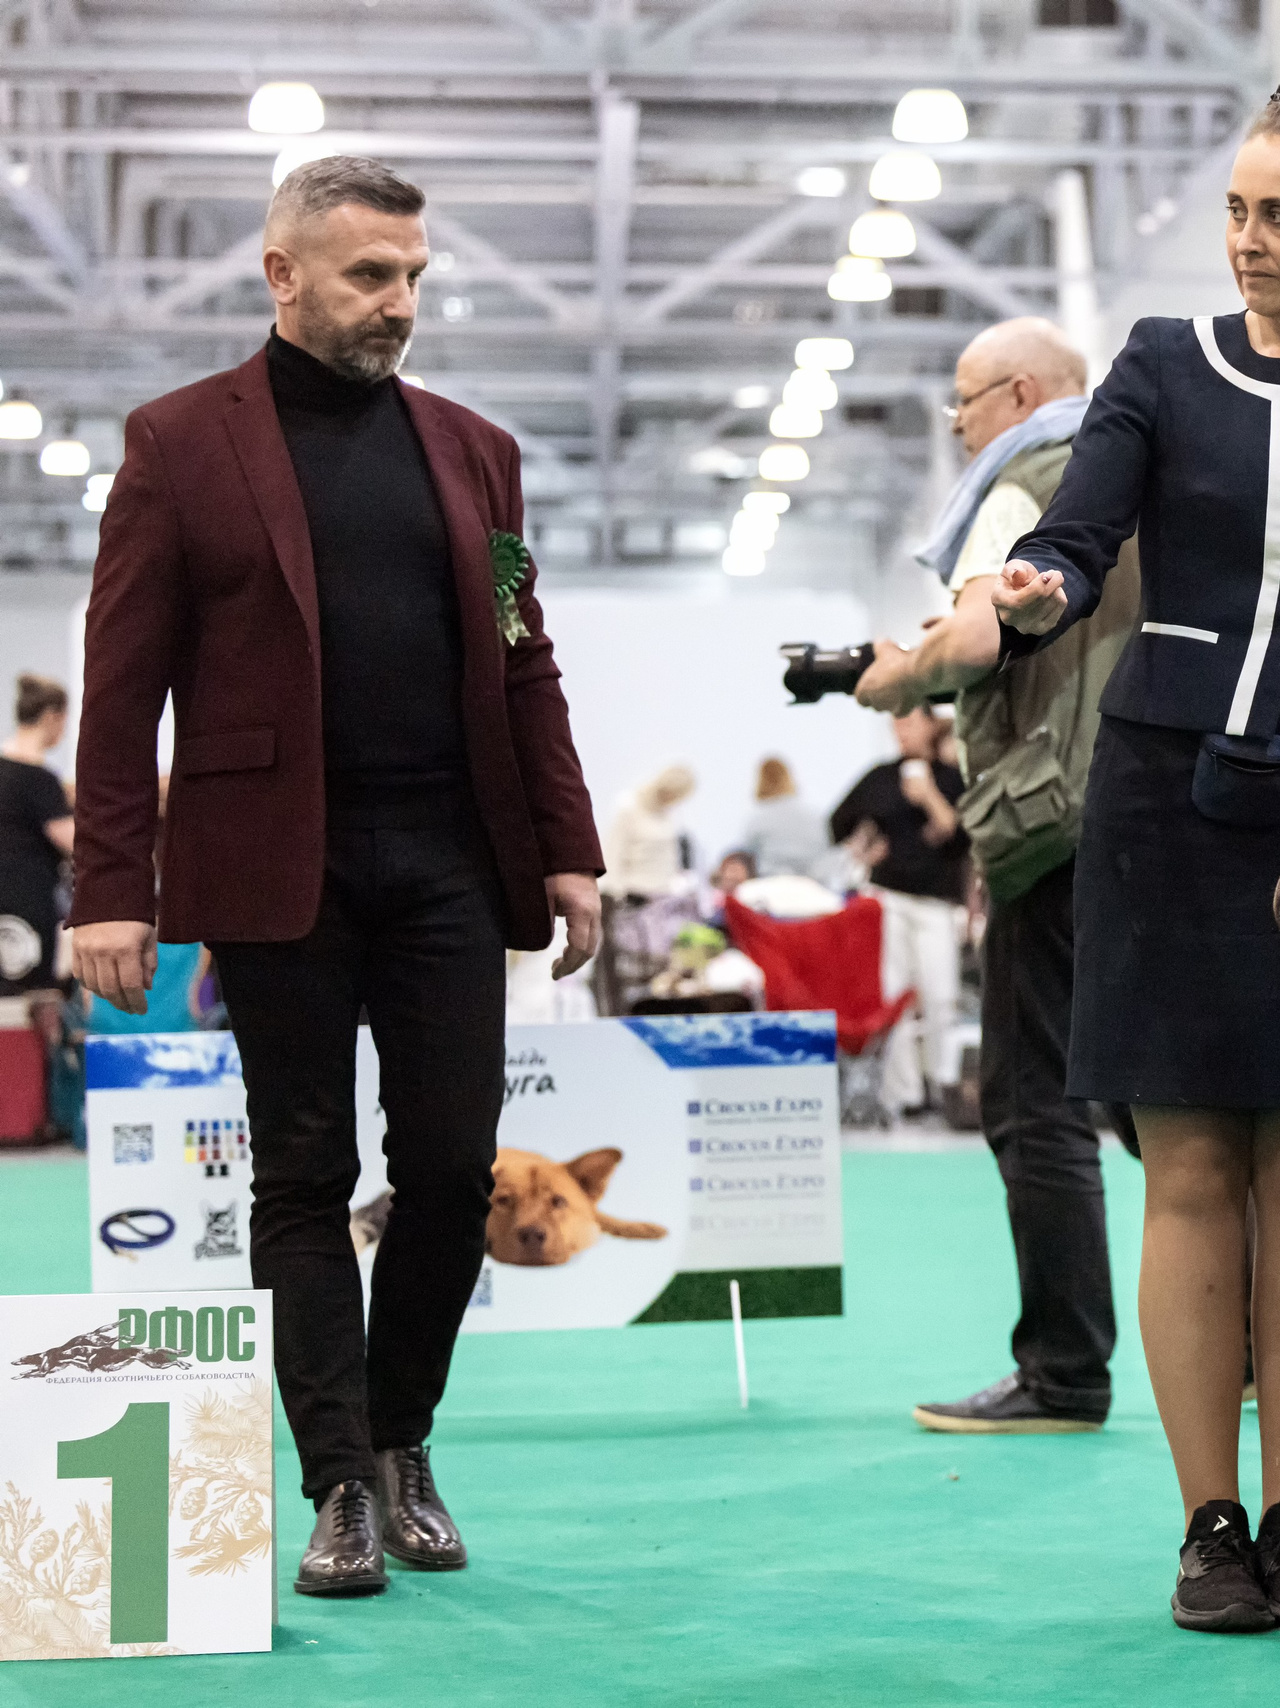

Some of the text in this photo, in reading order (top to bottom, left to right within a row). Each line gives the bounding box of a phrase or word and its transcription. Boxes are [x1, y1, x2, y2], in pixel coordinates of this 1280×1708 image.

[505, 1073, 556, 1105] уга
[118, 1305, 256, 1362] РФОС
[45, 1371, 256, 1385] ФЕДЕРАЦИЯ ОХОТНИЧЬЕГО СОБАКОВОДСТВА
[57, 1402, 170, 1644] 1
